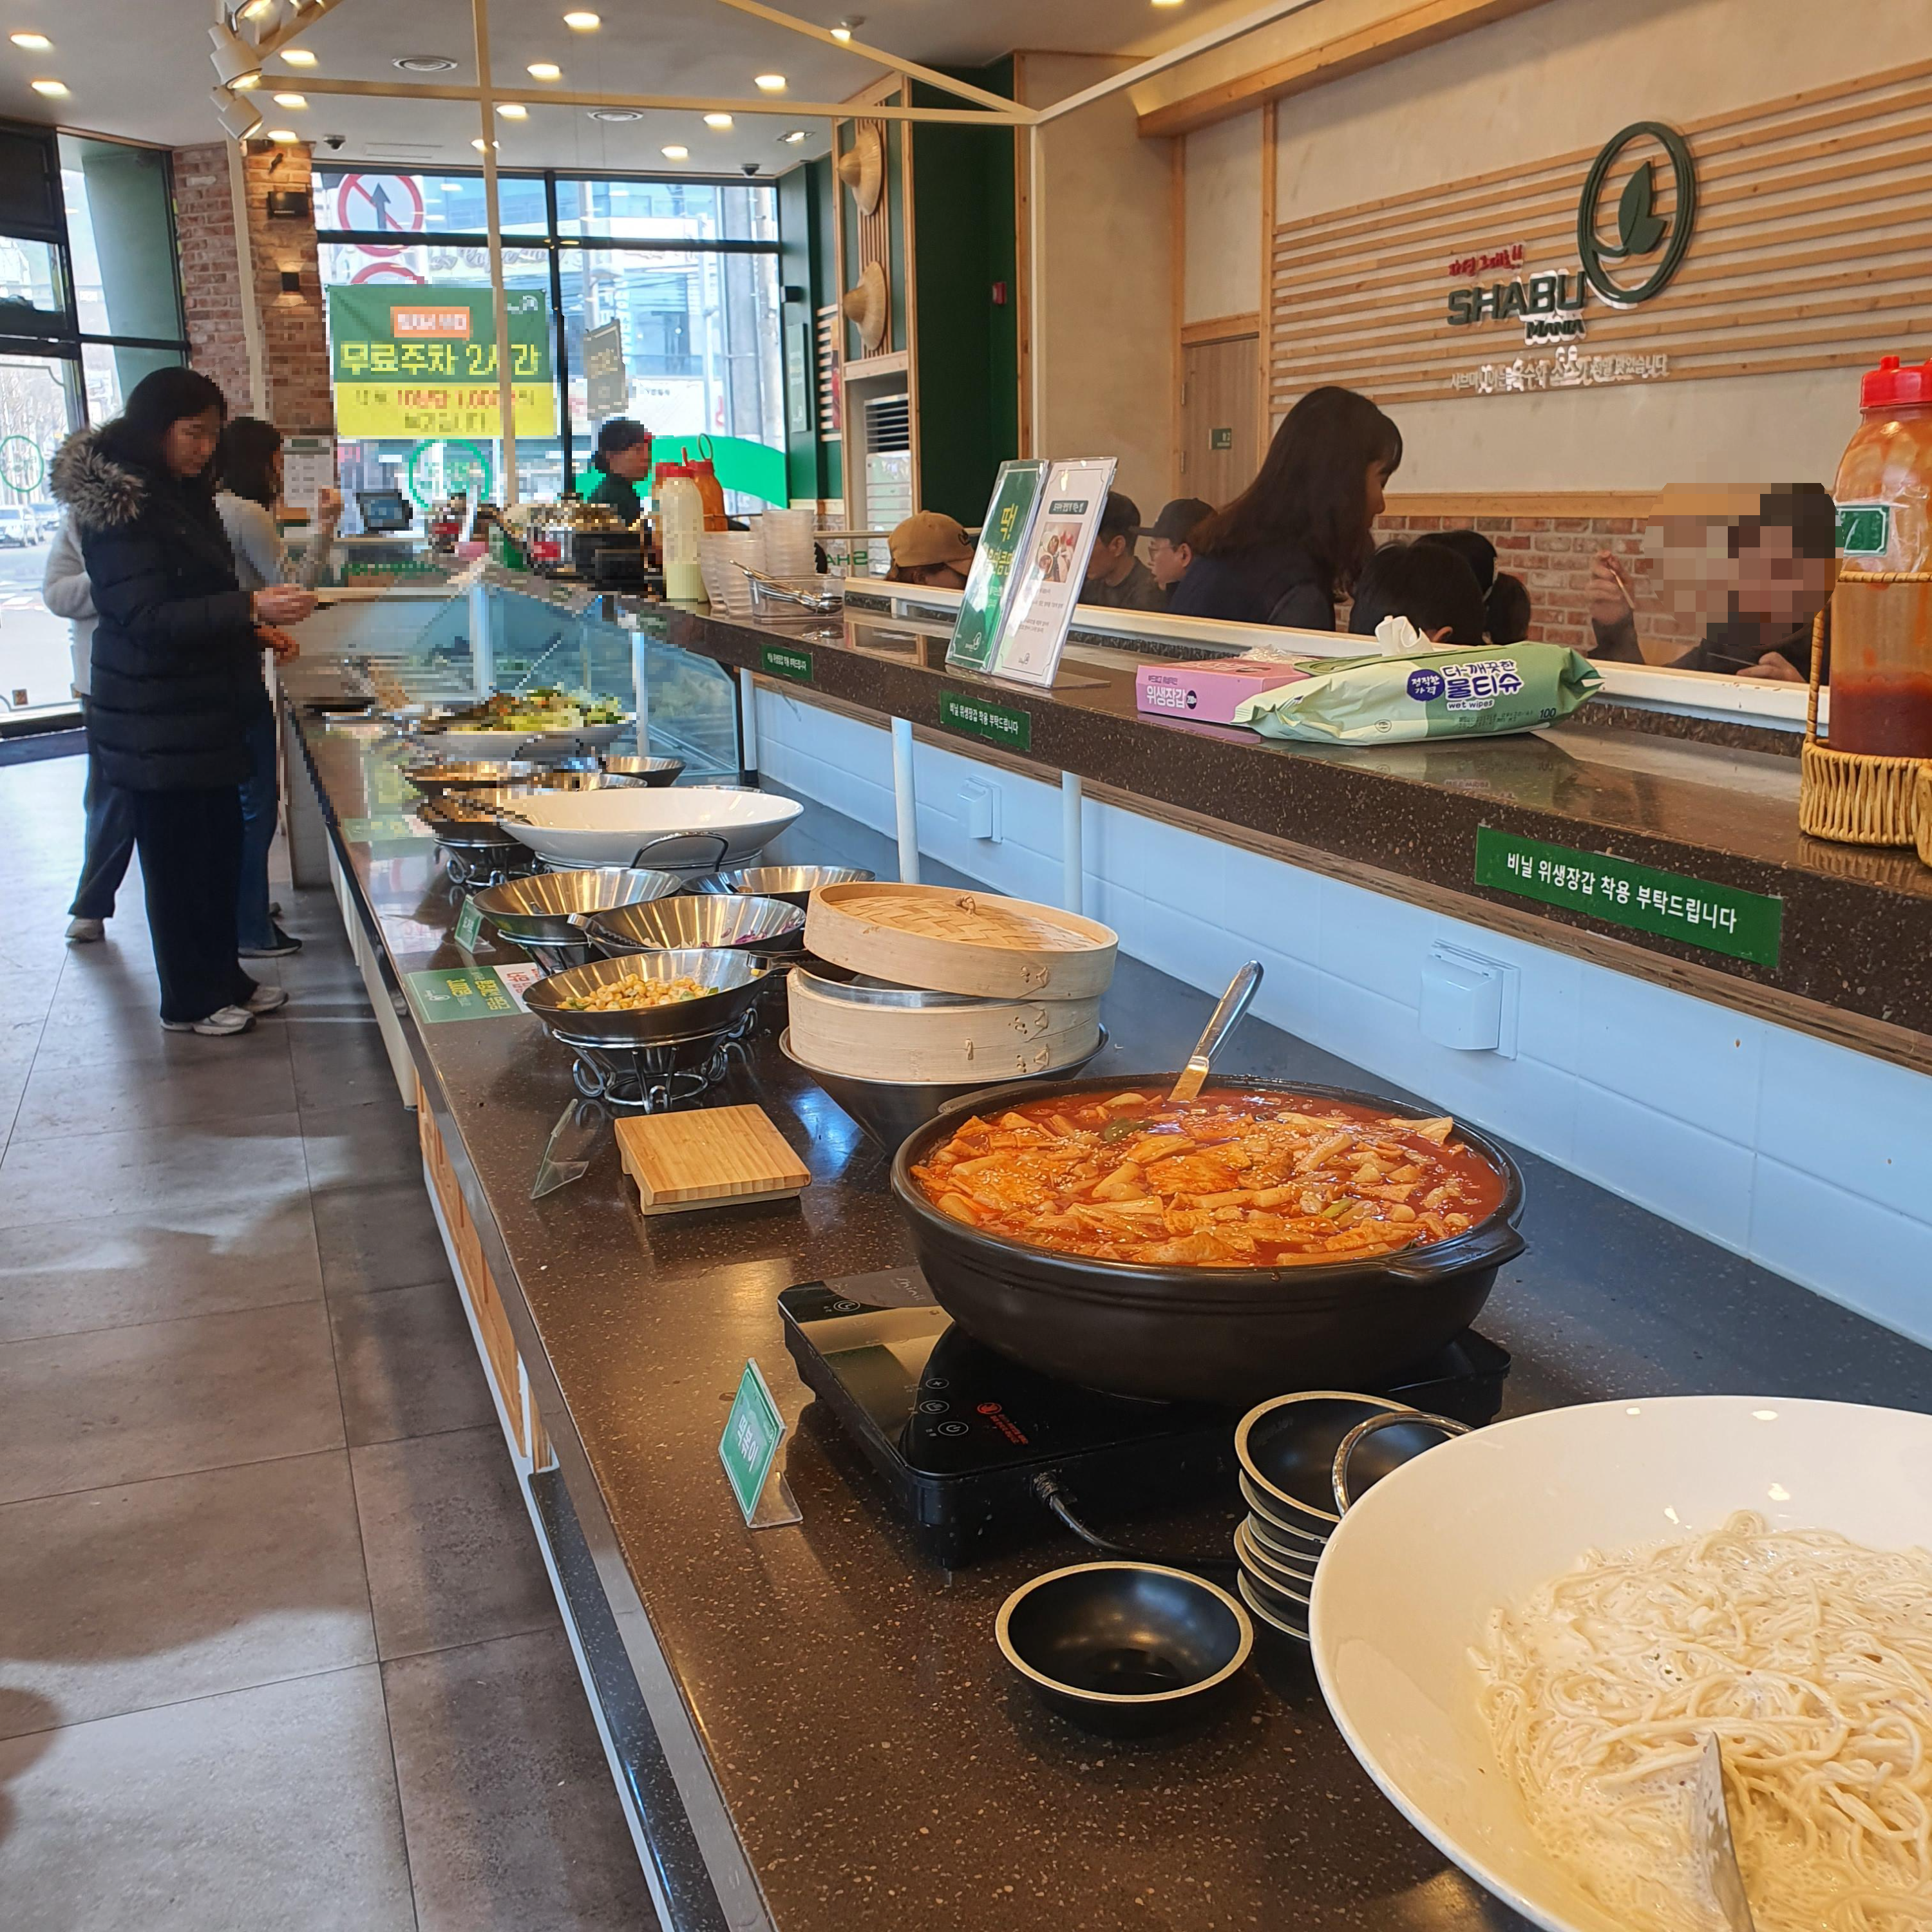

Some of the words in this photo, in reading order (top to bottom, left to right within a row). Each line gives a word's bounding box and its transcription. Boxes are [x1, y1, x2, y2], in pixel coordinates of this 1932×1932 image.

[1447, 271, 1585, 325] SHABU
[1526, 319, 1586, 339] MANIA
[341, 342, 458, 375] 무료주차
[1614, 353, 1669, 380] 맛있습니다
[1146, 685, 1186, 708] 위생장갑
[1415, 686, 1436, 696] 가격
[1447, 674, 1521, 699] 물티슈
[1469, 699, 1493, 709] wipes
[1540, 708, 1557, 719] 100
[949, 701, 958, 716] 비닐
[959, 705, 978, 722] 위생장갑
[978, 709, 988, 726] 착용
[989, 713, 1019, 735] 부탁드립니다
[1507, 853, 1533, 878] 비닐
[1538, 860, 1595, 895] 위생장갑
[1600, 876, 1630, 904] 착용
[1636, 884, 1737, 934] 부탁드립니다
[736, 1414, 759, 1473] 떡볶이
